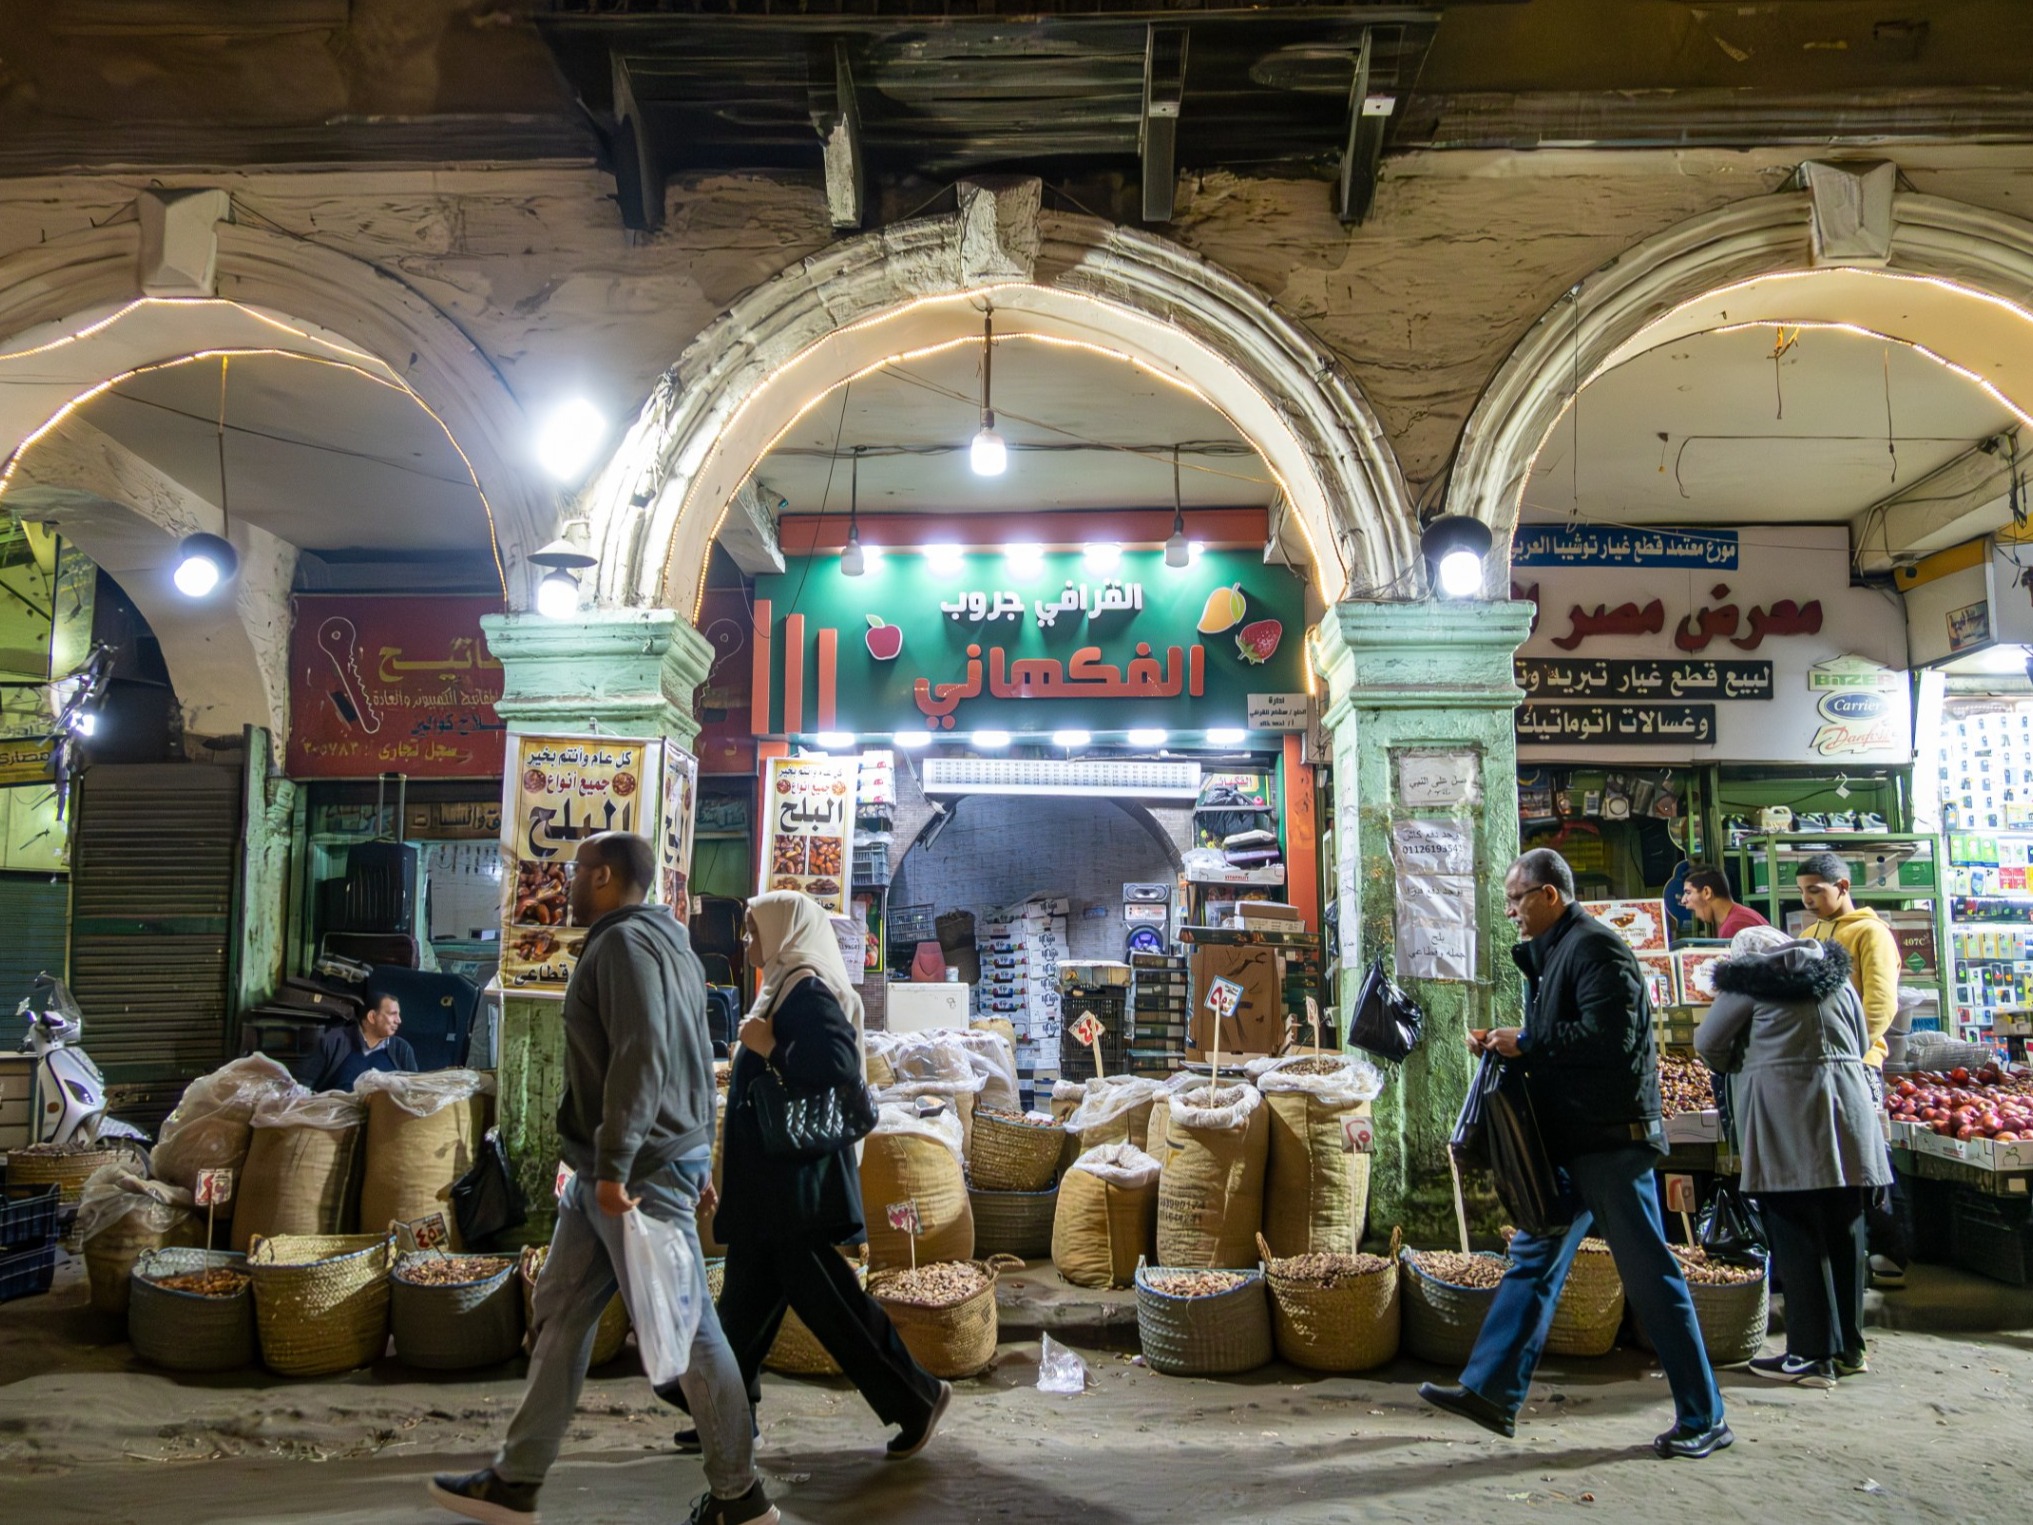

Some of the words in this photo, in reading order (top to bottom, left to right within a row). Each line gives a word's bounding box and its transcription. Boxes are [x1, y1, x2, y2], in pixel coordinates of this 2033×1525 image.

[1553, 533, 1598, 561] توشيبا
[1600, 533, 1631, 561] غيار
[1634, 534, 1664, 563] قطع
[1666, 537, 1704, 556] معتمد
[1706, 538, 1736, 563] موزع
[940, 588, 1025, 622] جروب
[1034, 580, 1143, 628] القرافي
[1674, 582, 1824, 652] معرض
[1551, 598, 1665, 651] مصر
[913, 643, 1205, 729] الفكهاني
[1616, 663, 1664, 694] غيار
[1670, 661, 1719, 697] قطع
[1724, 665, 1770, 698] لبيع
[1833, 699, 1880, 712] Carrier
[1516, 705, 1612, 740] اتوماتيك
[1618, 707, 1709, 740] وغسالات
[527, 747, 556, 767] بخير
[558, 747, 589, 768] وأنتم
[591, 750, 613, 767] عام
[615, 750, 632, 769] كل
[546, 770, 577, 795] أنواع
[578, 776, 610, 797] جميع
[528, 797, 631, 857] البلح
[779, 796, 843, 833] البلح
[1903, 937, 1926, 947] 407C
